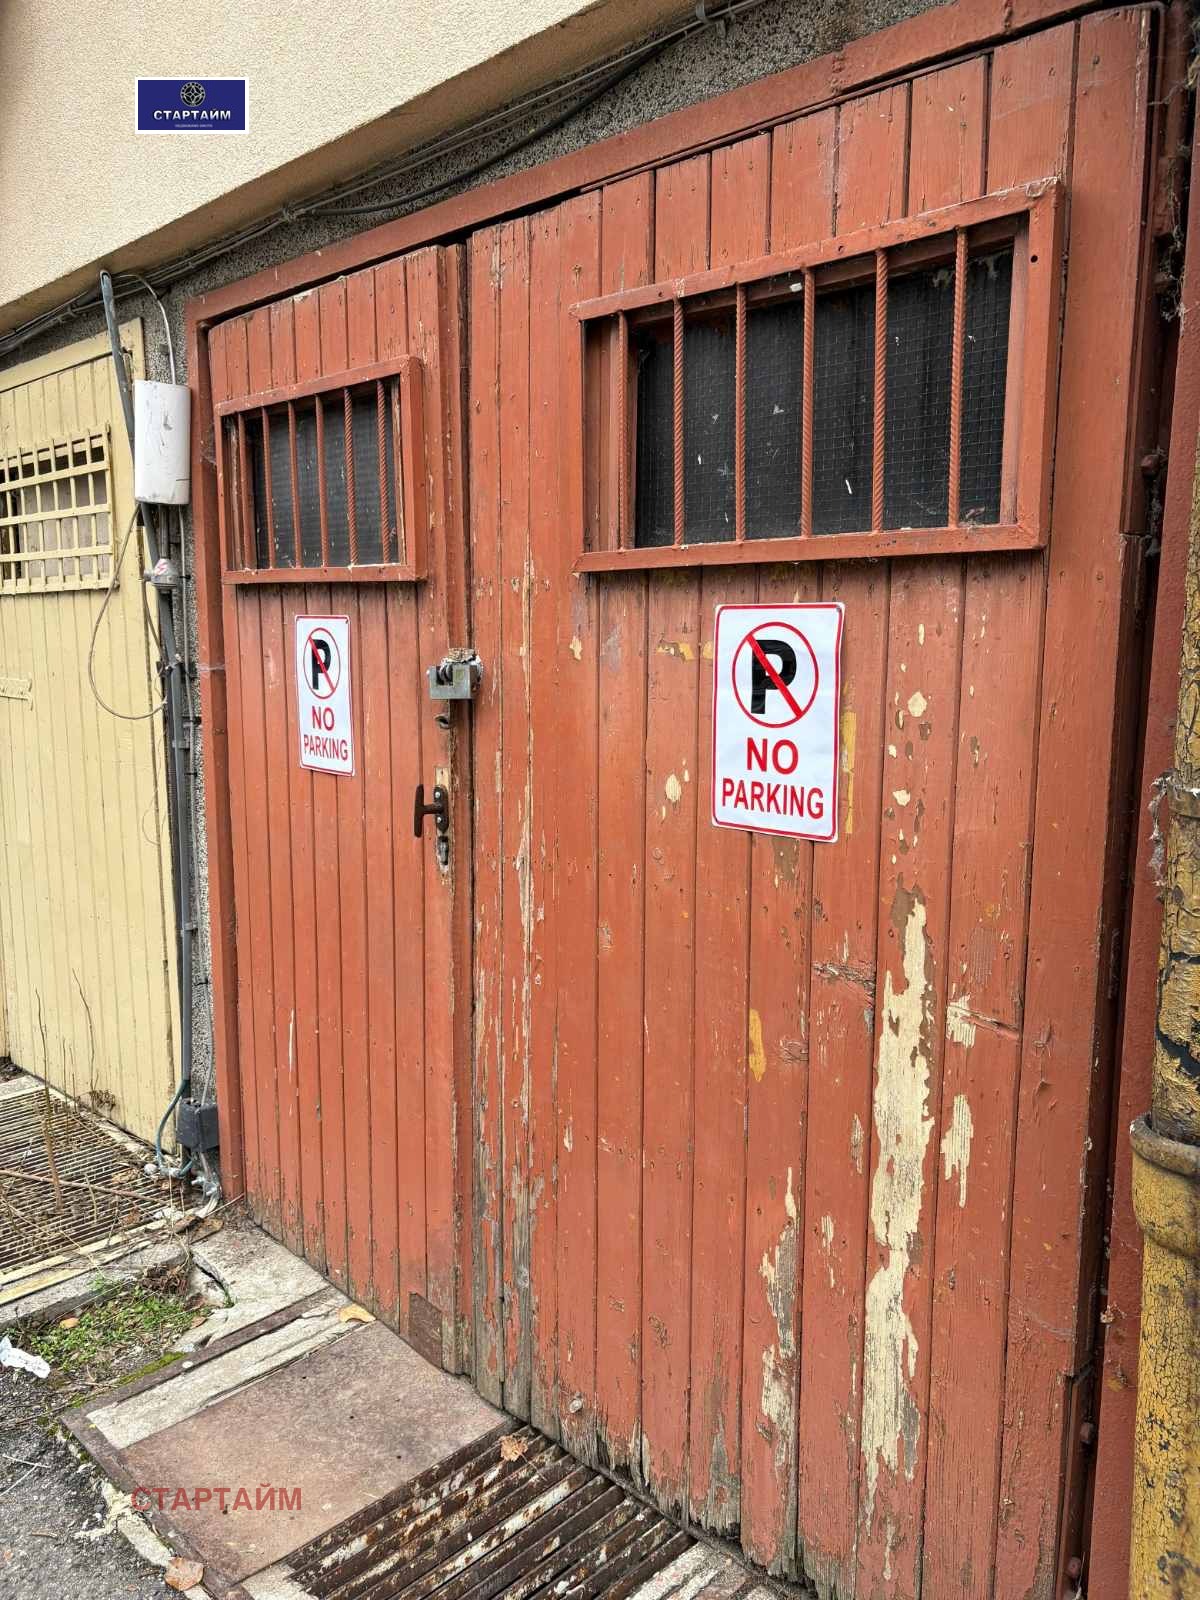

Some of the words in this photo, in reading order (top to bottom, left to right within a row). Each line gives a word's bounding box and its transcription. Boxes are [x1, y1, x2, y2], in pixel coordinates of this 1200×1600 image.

[311, 639, 331, 690] P
[750, 639, 797, 714] P
[311, 706, 335, 731] NO
[303, 734, 348, 761] PARKING
[746, 737, 799, 775] NO
[722, 777, 824, 820] PARKING
